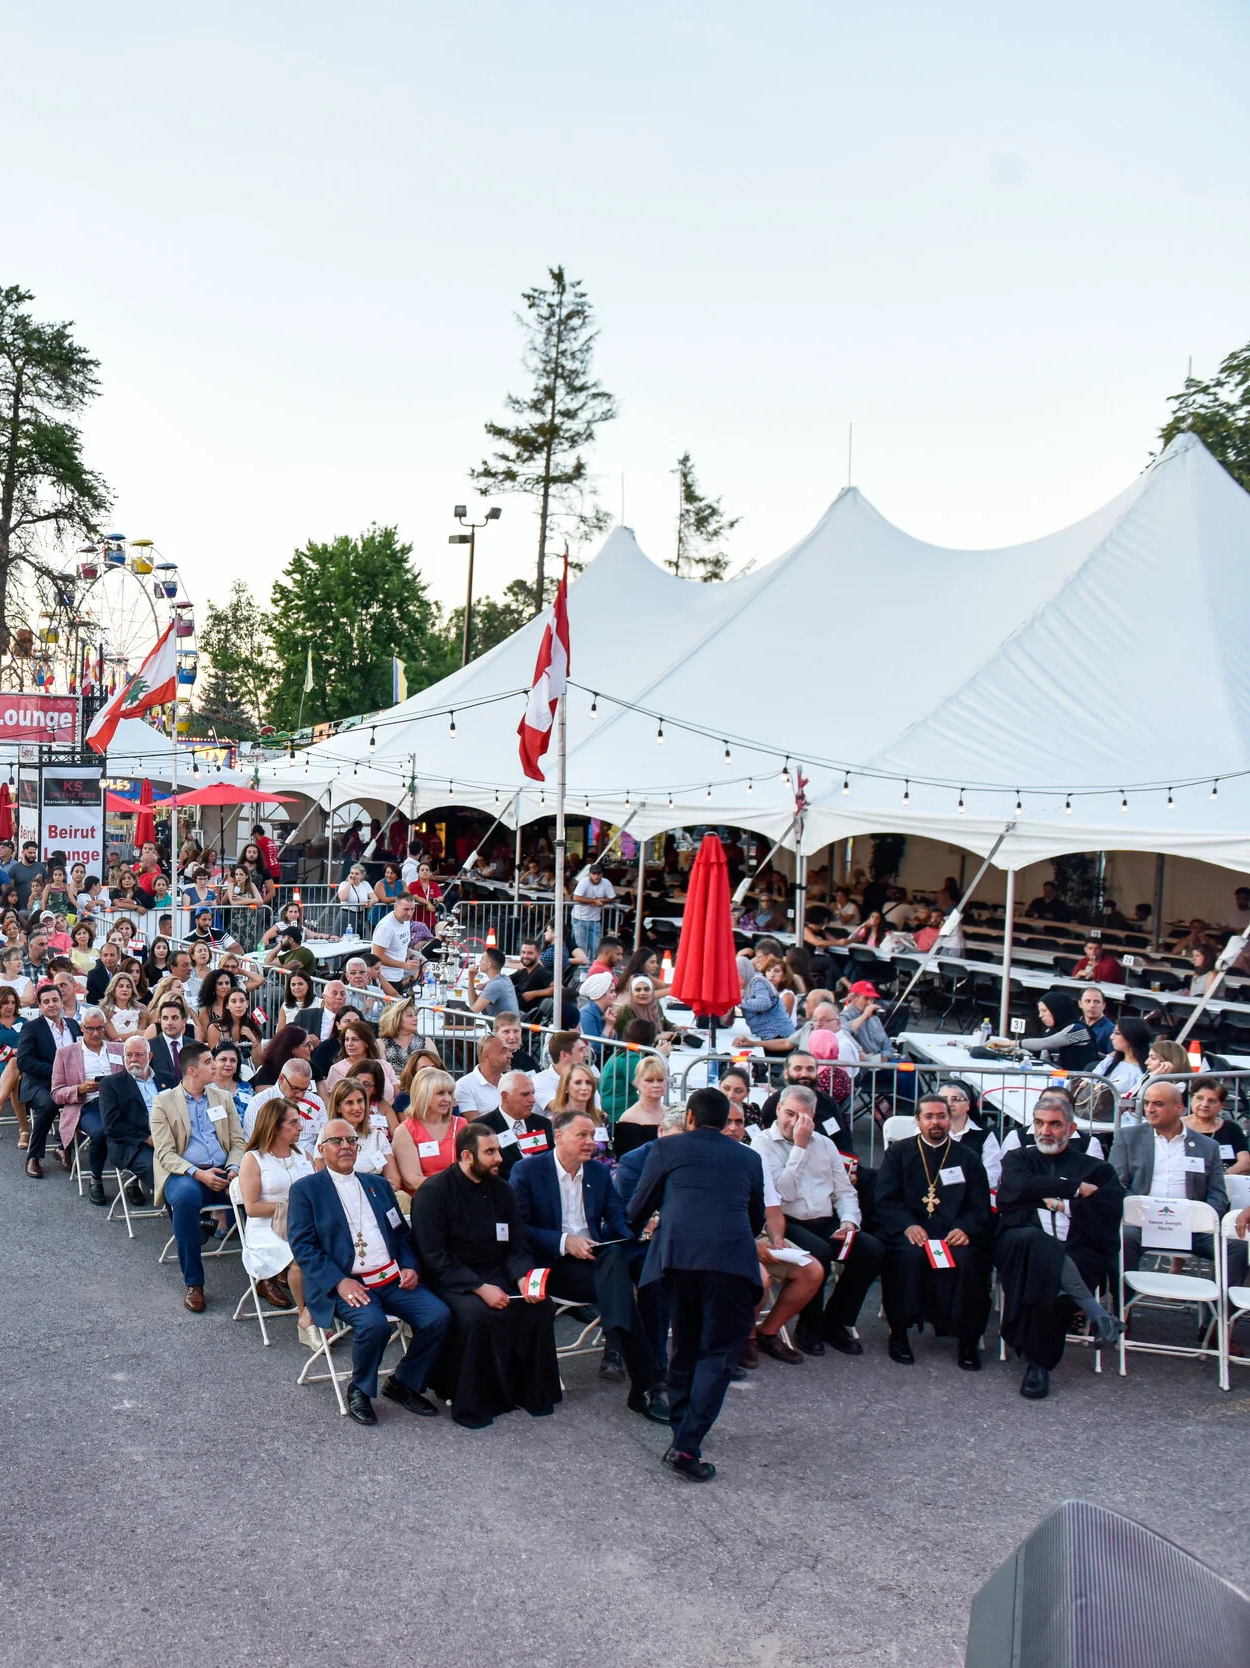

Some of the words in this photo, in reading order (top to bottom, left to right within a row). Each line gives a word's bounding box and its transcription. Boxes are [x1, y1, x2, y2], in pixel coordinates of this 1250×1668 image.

[62, 781, 84, 791] KS
[19, 824, 37, 841] Beirut
[47, 824, 96, 839] Beirut
[43, 847, 100, 865] Lunge
[431, 963, 441, 972] 36
[1013, 1019, 1024, 1030] 31
